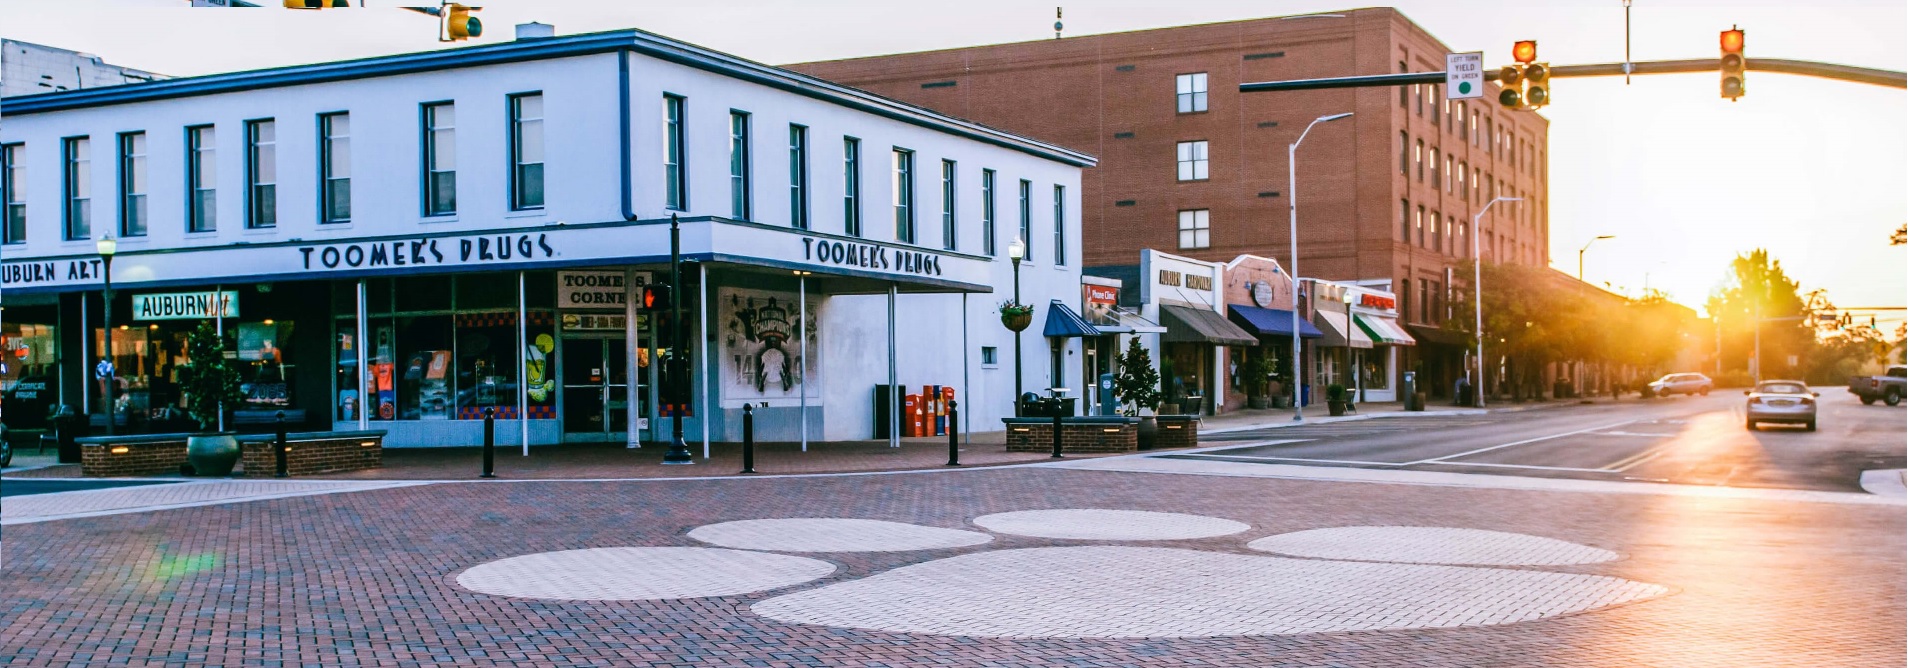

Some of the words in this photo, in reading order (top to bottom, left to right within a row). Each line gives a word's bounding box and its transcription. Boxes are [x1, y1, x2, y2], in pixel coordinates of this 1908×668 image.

[300, 238, 443, 270] TOOMER'S
[461, 234, 553, 262] DRUGS
[802, 238, 889, 269] TOOMER'S
[896, 251, 941, 275] DRUGS
[2, 262, 55, 283] UBURN
[68, 260, 101, 280] ART
[564, 275, 644, 287] TOOMES
[142, 294, 207, 317] AUBURN
[755, 318, 790, 336] CHAMPIONS
